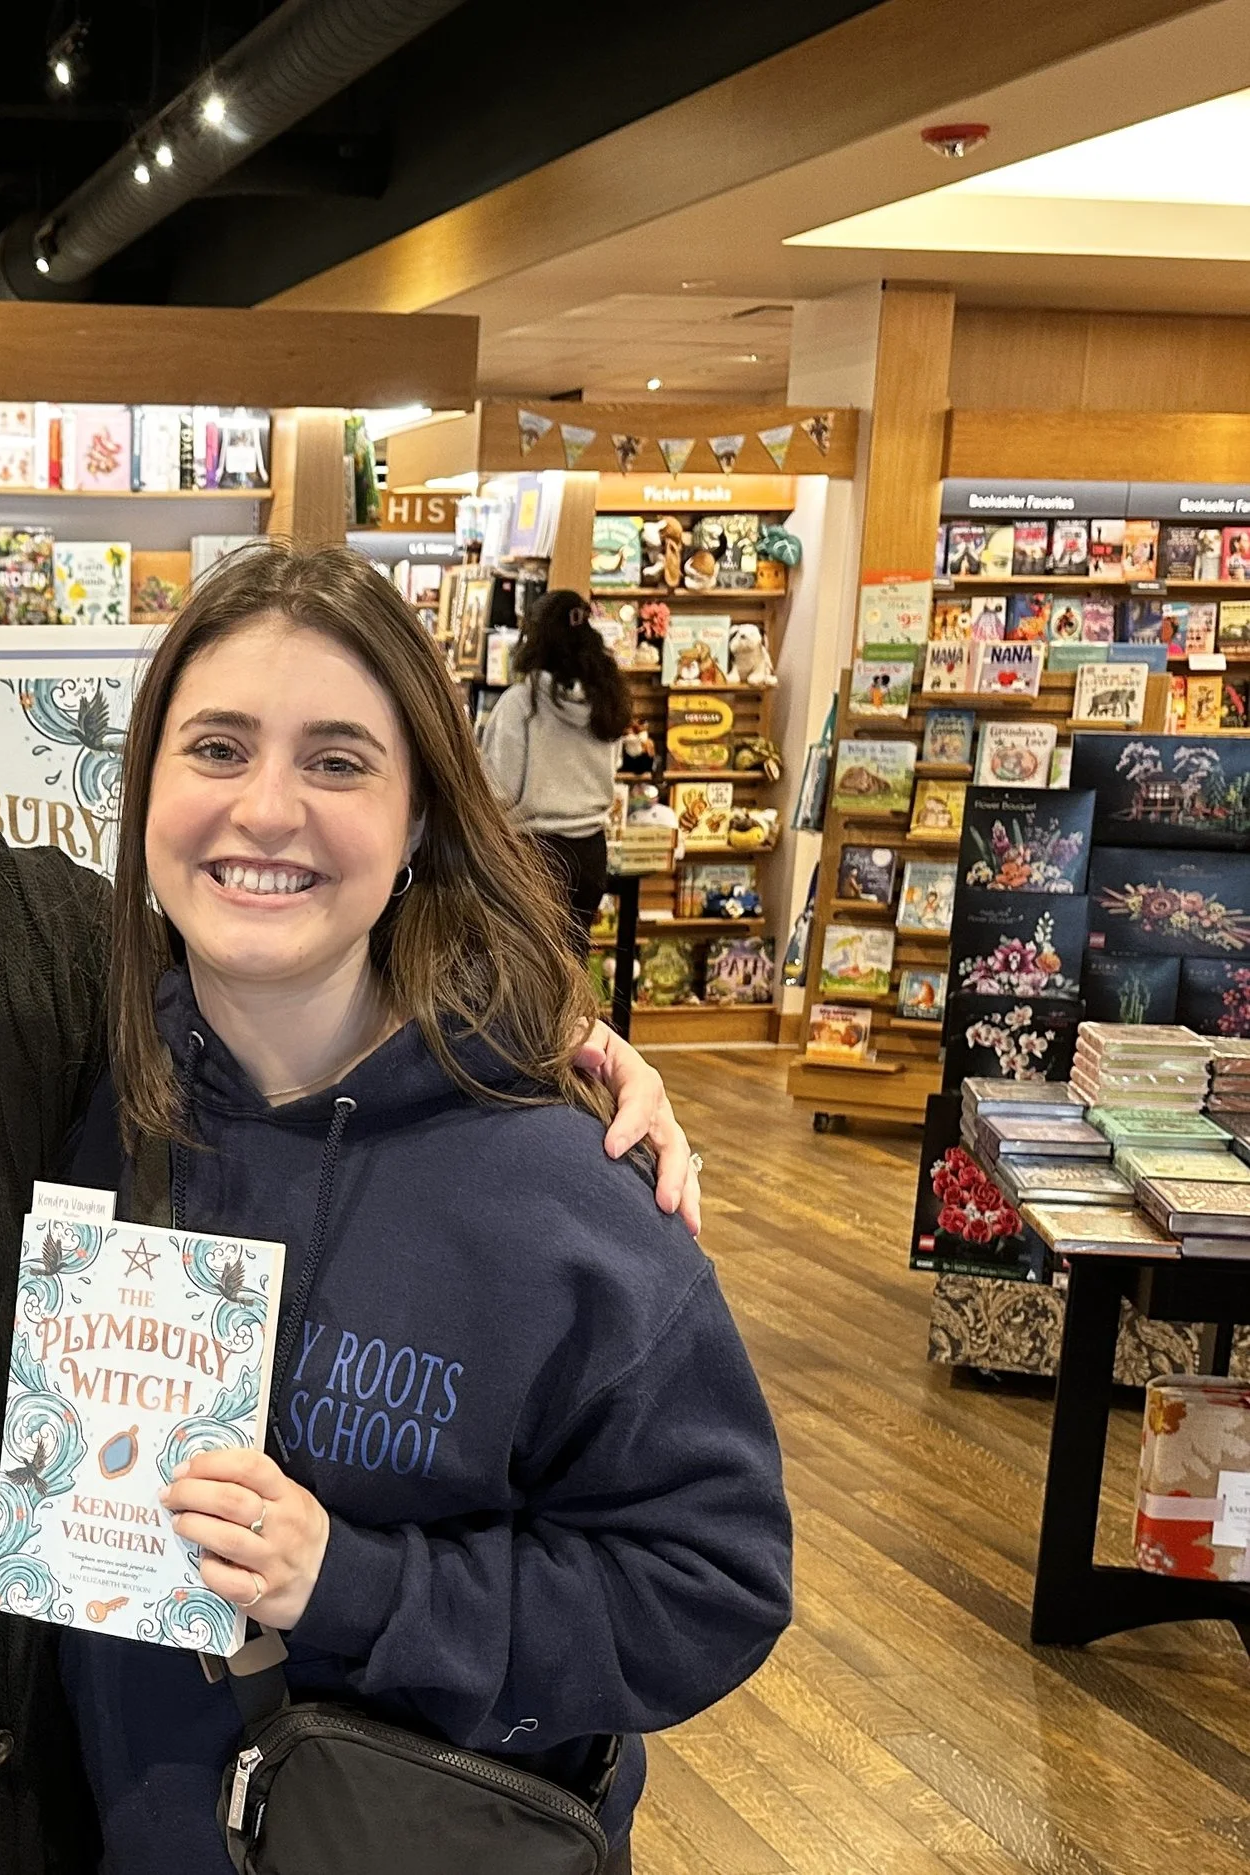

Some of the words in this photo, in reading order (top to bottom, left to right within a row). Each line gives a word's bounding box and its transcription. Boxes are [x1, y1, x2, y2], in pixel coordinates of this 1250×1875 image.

[643, 485, 690, 502] Picture
[692, 485, 733, 502] Books
[969, 493, 1026, 509] Bookseller
[388, 497, 454, 524] HIS
[991, 645, 1033, 664] NANA
[38, 1193, 69, 1209] Kendra
[118, 1287, 155, 1308] THE
[35, 1312, 236, 1383] PLYMBURY
[59, 1357, 193, 1414] WITCH
[326, 1330, 464, 1423] ROOTS
[285, 1390, 442, 1480] SCHOOL
[72, 1494, 161, 1527] KENDRA
[61, 1520, 166, 1556] VAUGHAN
